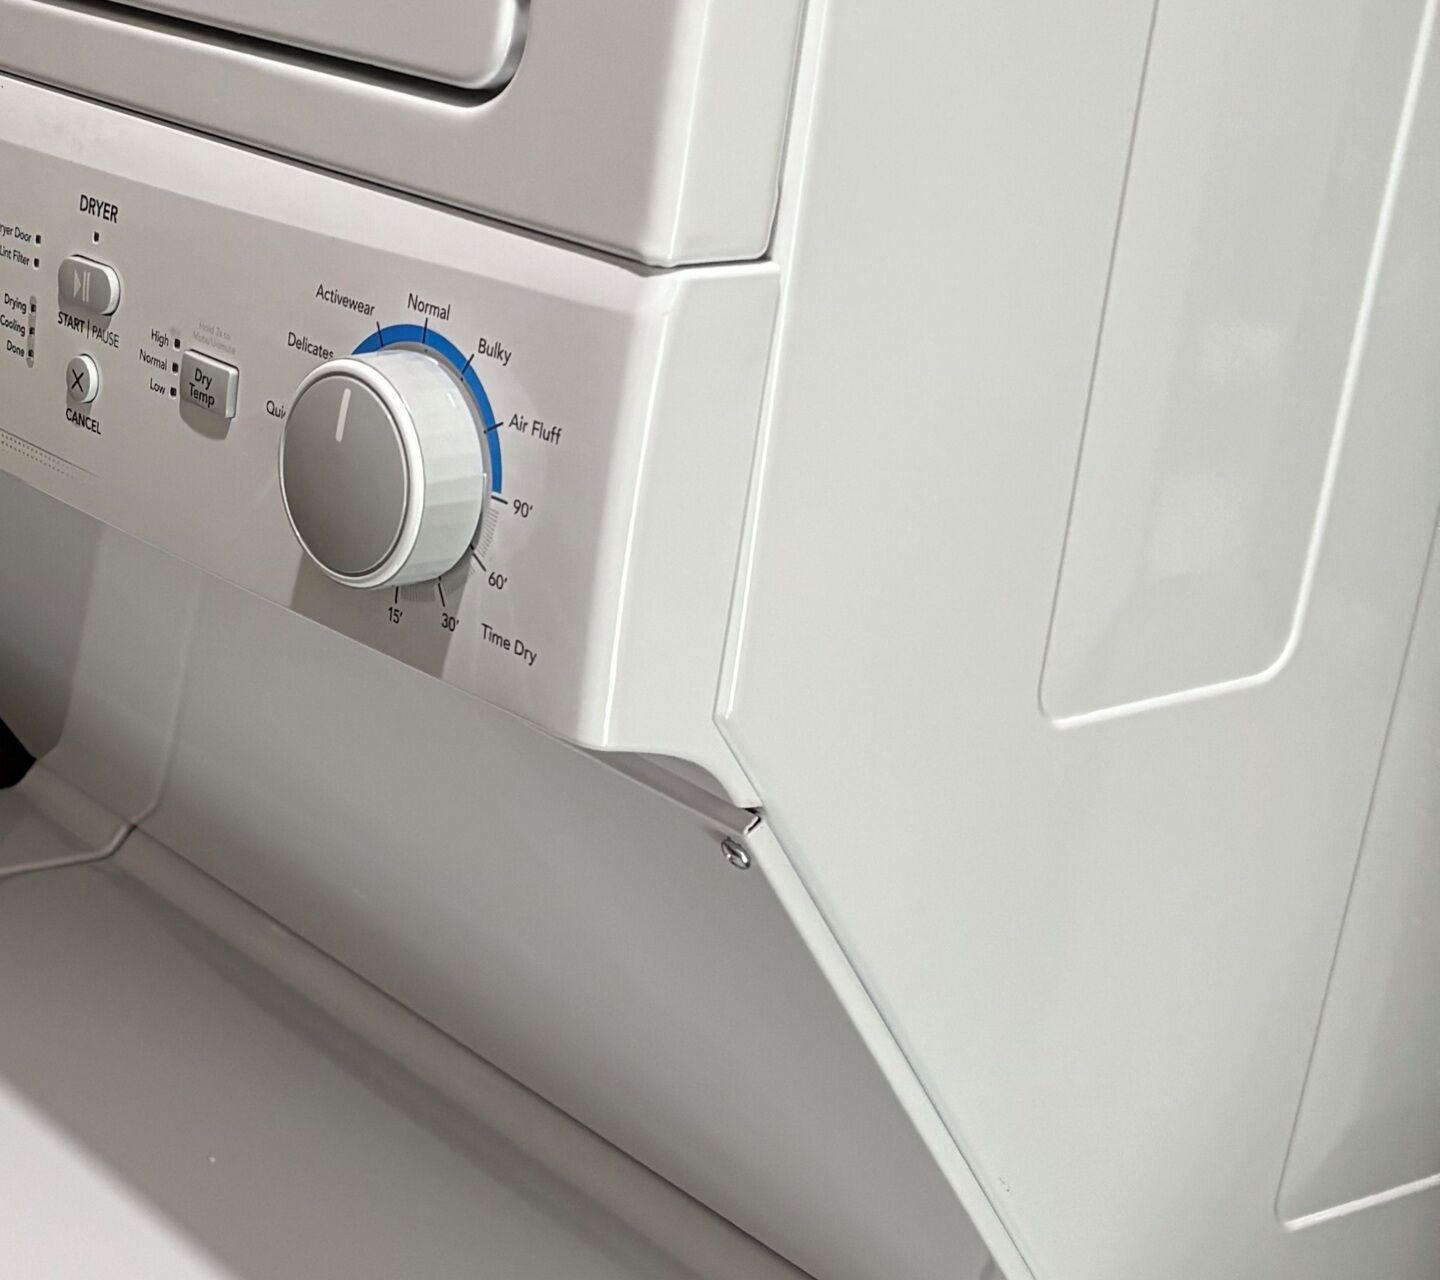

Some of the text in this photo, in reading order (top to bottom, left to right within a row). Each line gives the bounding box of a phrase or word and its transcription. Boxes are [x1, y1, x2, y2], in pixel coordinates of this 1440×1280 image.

[79, 194, 119, 224] DRYER
[14, 226, 32, 243] Door
[0, 245, 12, 260] Lint
[12, 250, 30, 266] Filter
[4, 292, 27, 315] Drying
[316, 284, 376, 317] Activewear
[407, 293, 451, 321] Normal
[0, 314, 26, 338] Cooling
[57, 311, 120, 349] START PAUSE
[151, 328, 169, 347] High
[6, 338, 25, 357] Done
[139, 348, 168, 370] Normal
[287, 332, 335, 360] Delicates
[478, 337, 512, 366] Bulky
[149, 378, 165, 395] Low
[194, 367, 213, 391] Dry
[188, 382, 215, 408] Temp
[65, 407, 102, 435] CANCEL
[508, 414, 563, 445] Air Fluff
[481, 623, 537, 666] Time Dry
